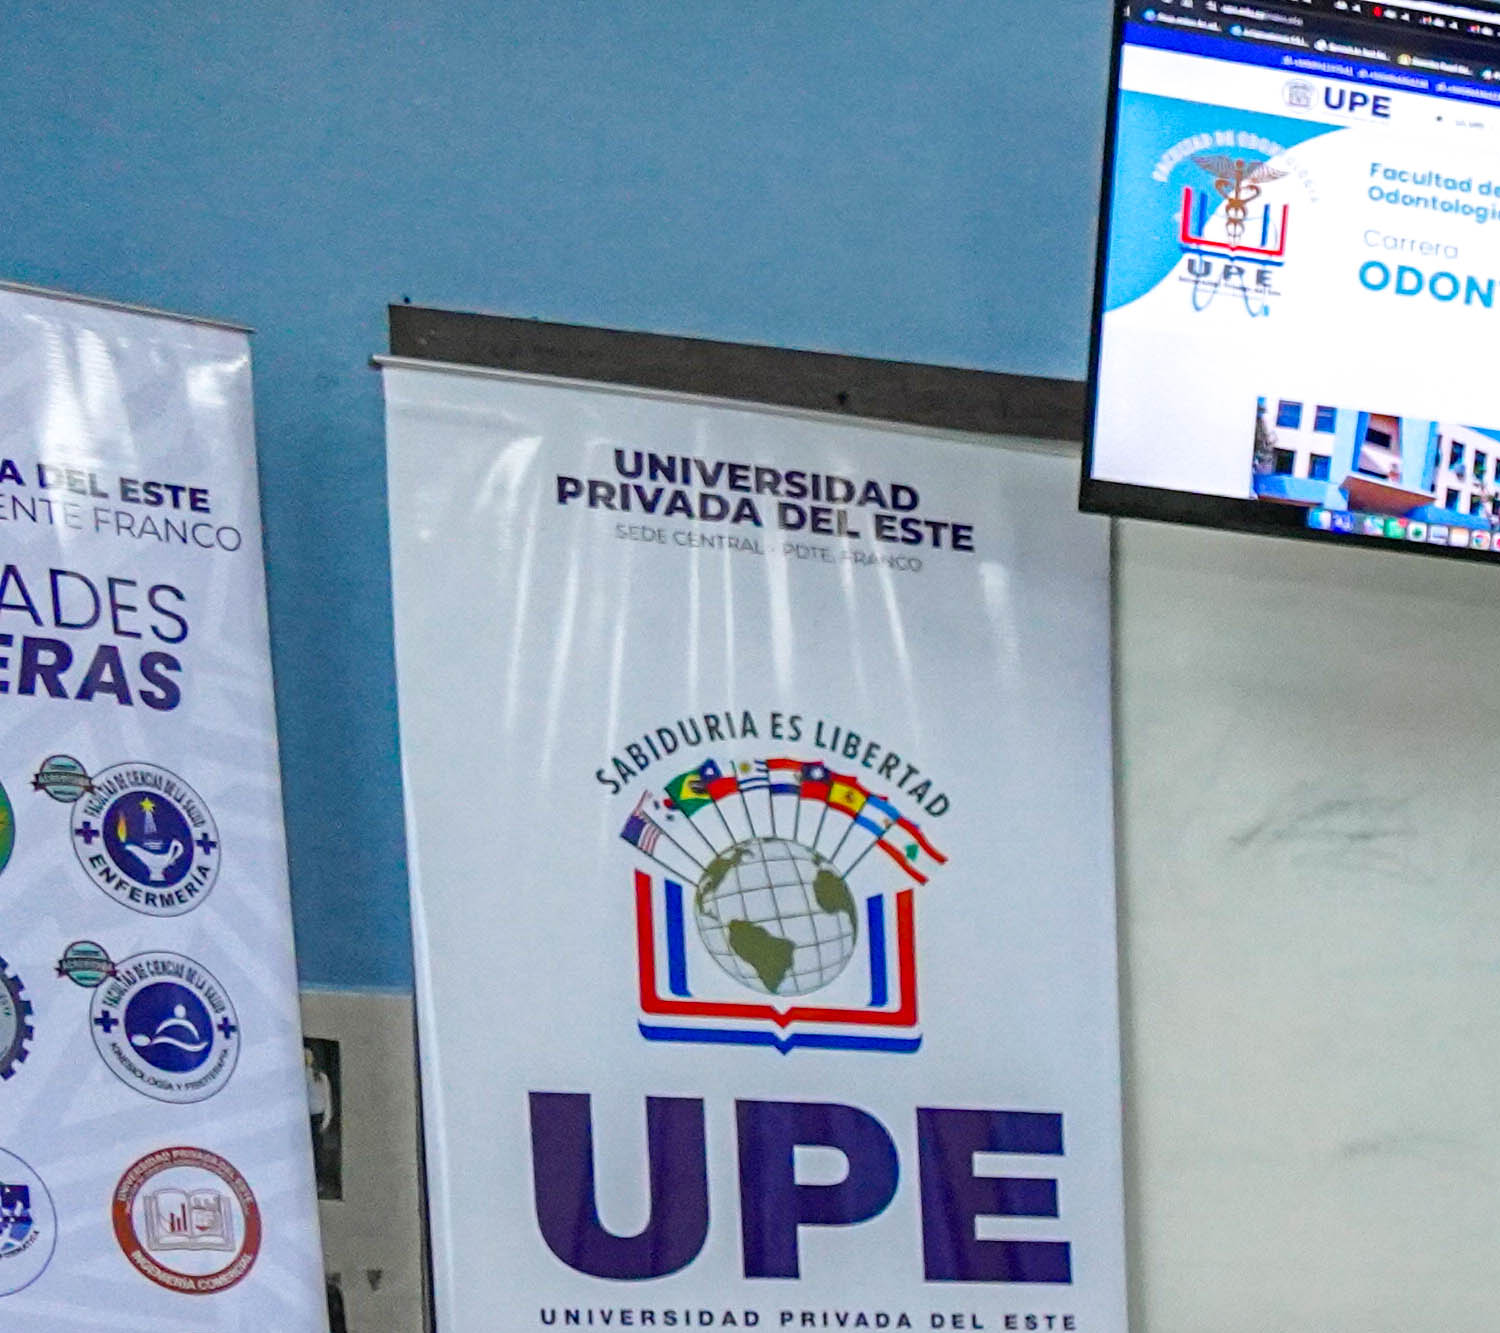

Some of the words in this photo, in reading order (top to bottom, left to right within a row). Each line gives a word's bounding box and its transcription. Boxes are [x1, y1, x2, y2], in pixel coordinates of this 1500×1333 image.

[1324, 86, 1392, 119] UPE
[1370, 162, 1473, 193] Facultad
[1363, 229, 1459, 259] Carrera
[1187, 258, 1273, 287] UPE
[36, 464, 108, 498] DEL
[120, 477, 211, 513] ESTE
[614, 447, 920, 512] UNIVERSIDAD
[94, 506, 241, 551] FRANCO
[557, 474, 762, 528] PRIVADA
[778, 500, 860, 539] DEL
[874, 513, 976, 553] ESTE
[615, 523, 666, 546] SEDE
[673, 529, 765, 557] CENTRAL
[0, 564, 188, 644] ADES
[595, 709, 759, 796] SABIDURIA
[771, 711, 800, 742] ES
[814, 720, 951, 819] LIBERTAD
[89, 854, 211, 907] ENFERMERÍA
[528, 1091, 1074, 1286] UPE
[540, 1308, 762, 1328] UNIVERSIDAD
[780, 1311, 913, 1330] PRIVADA
[931, 1313, 985, 1331] DEL
[1004, 1314, 1078, 1332] ESTE
